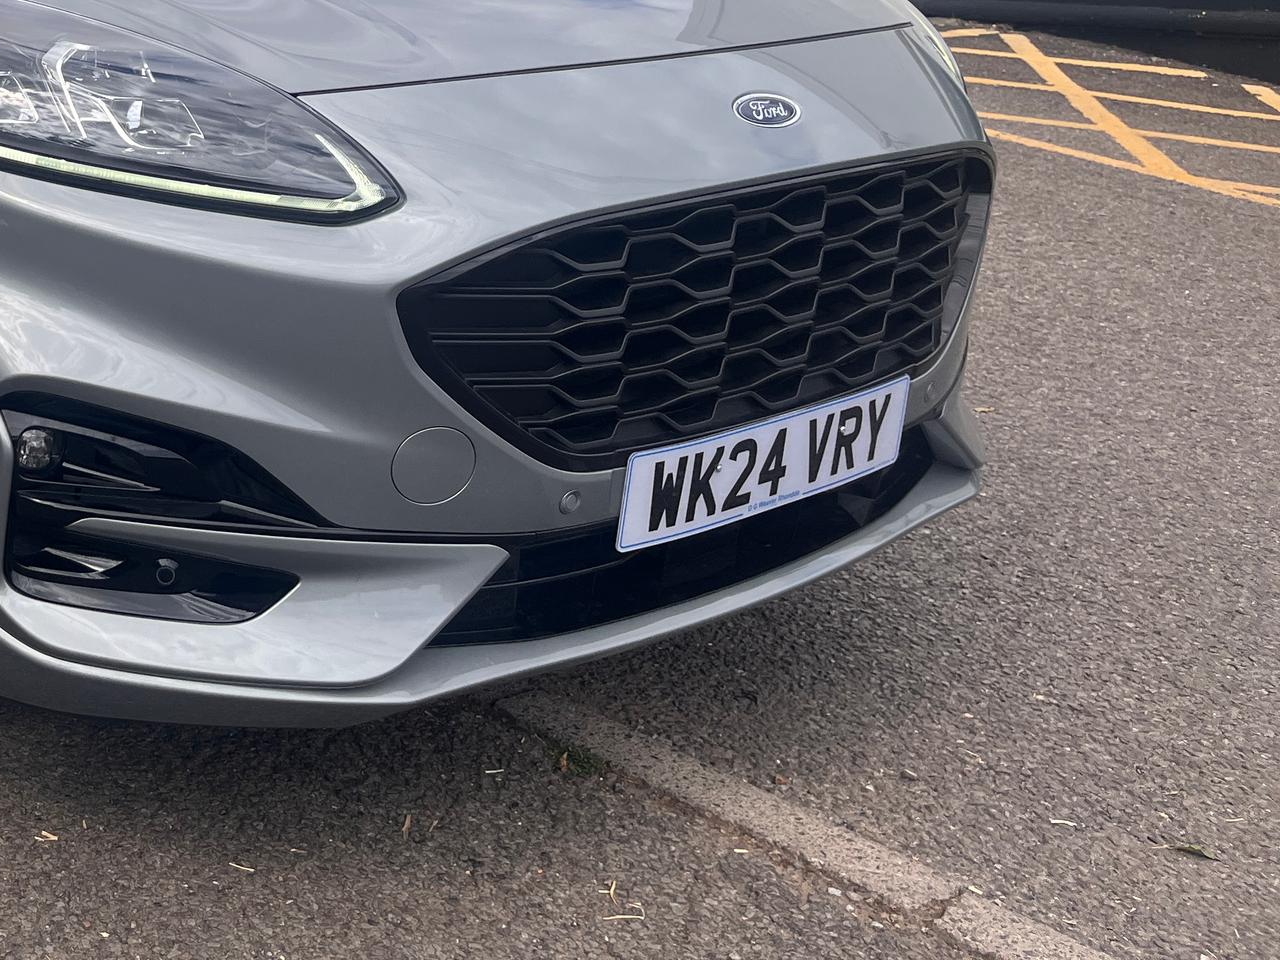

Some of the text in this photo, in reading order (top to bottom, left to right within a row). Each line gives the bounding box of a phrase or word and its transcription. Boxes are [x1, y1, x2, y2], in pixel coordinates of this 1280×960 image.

[749, 100, 788, 120] Ford
[648, 393, 892, 533] WK24 VRY
